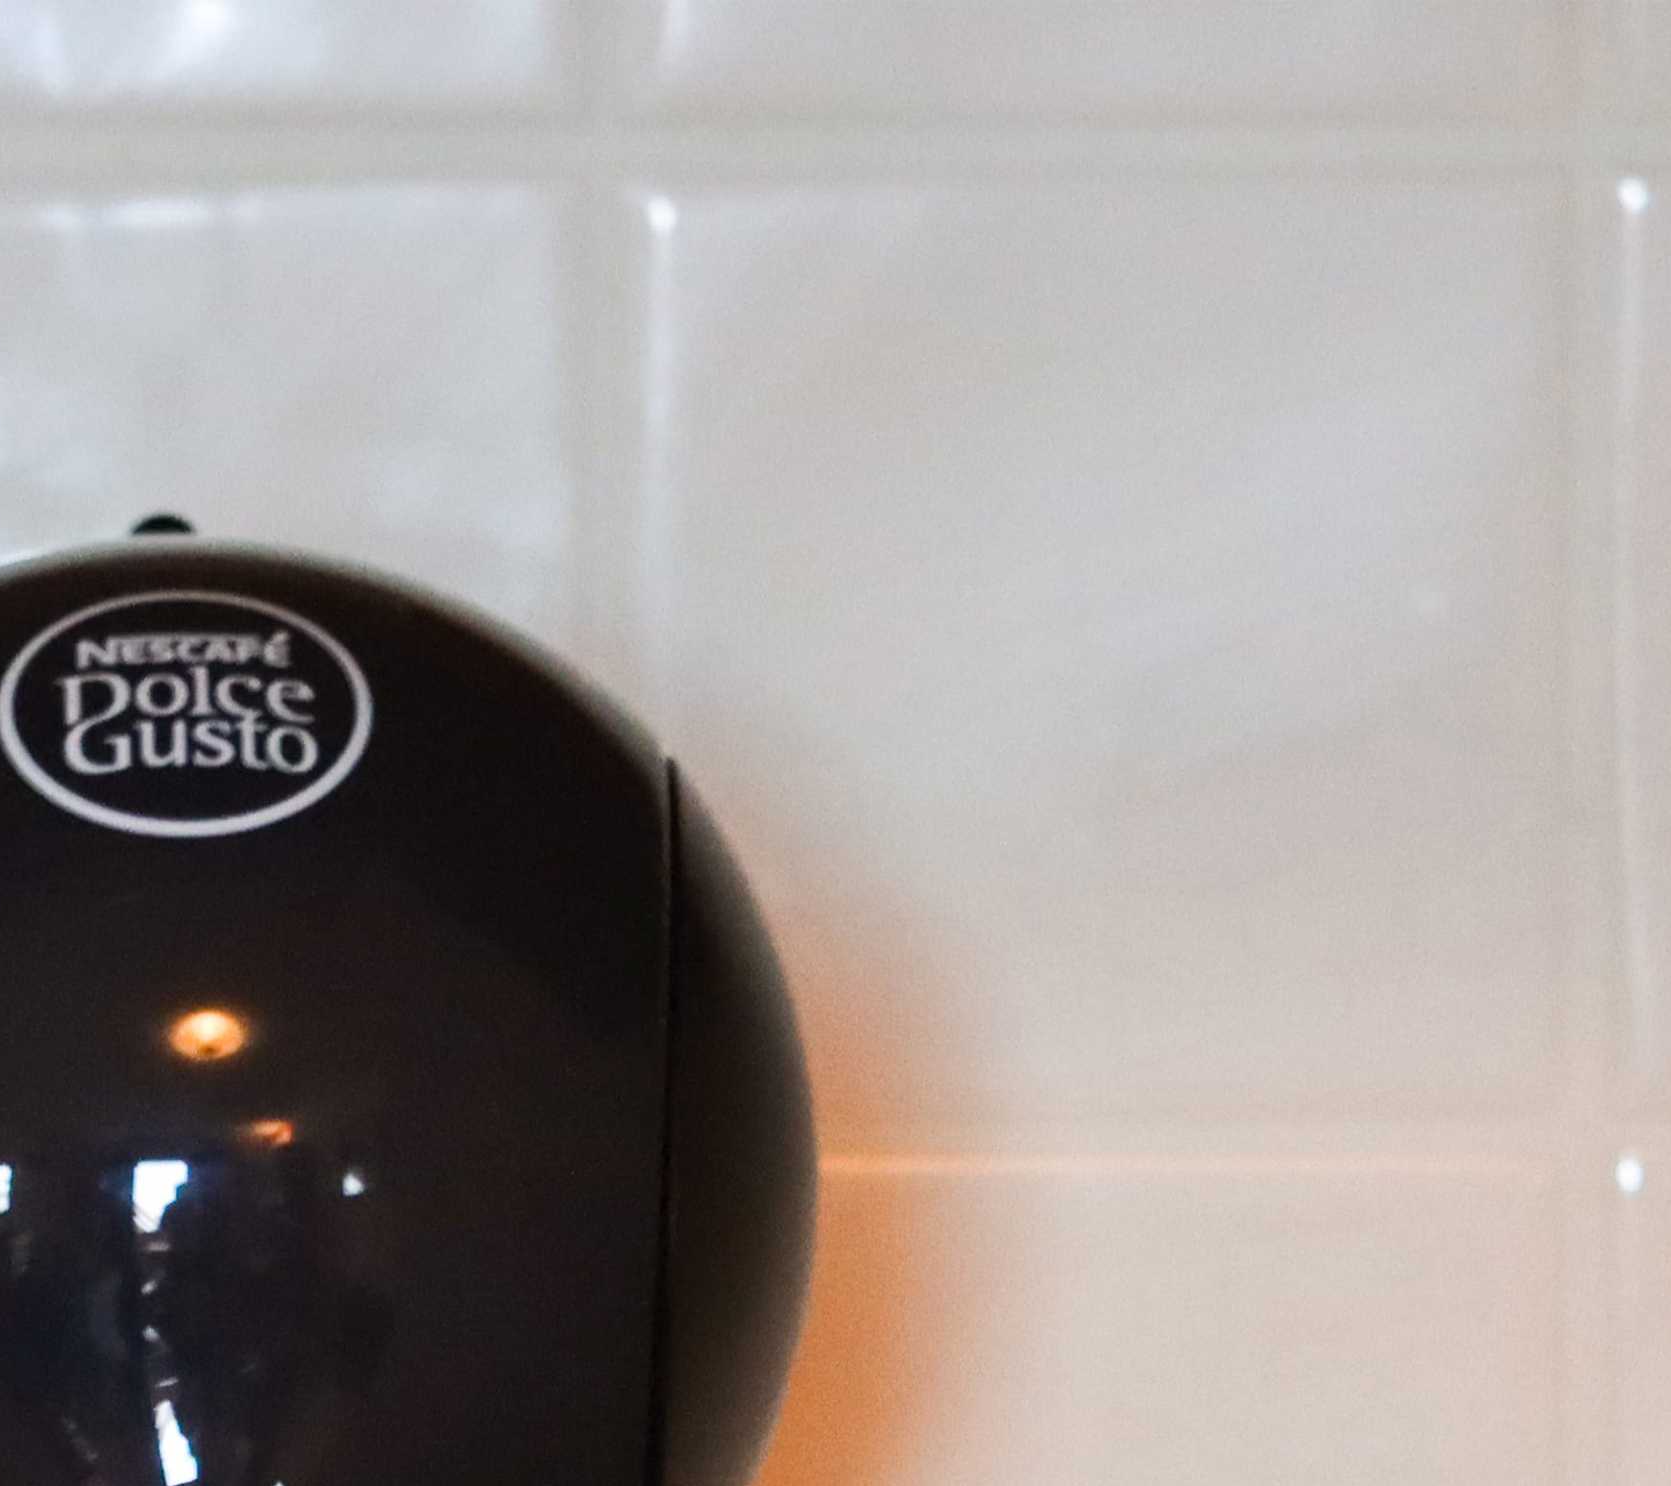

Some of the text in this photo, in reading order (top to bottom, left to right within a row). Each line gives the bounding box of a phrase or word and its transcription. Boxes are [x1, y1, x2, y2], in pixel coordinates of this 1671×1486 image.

[76, 630, 291, 669] NESCAFÉ
[54, 666, 316, 726] Dolce
[63, 710, 319, 775] Gusto
